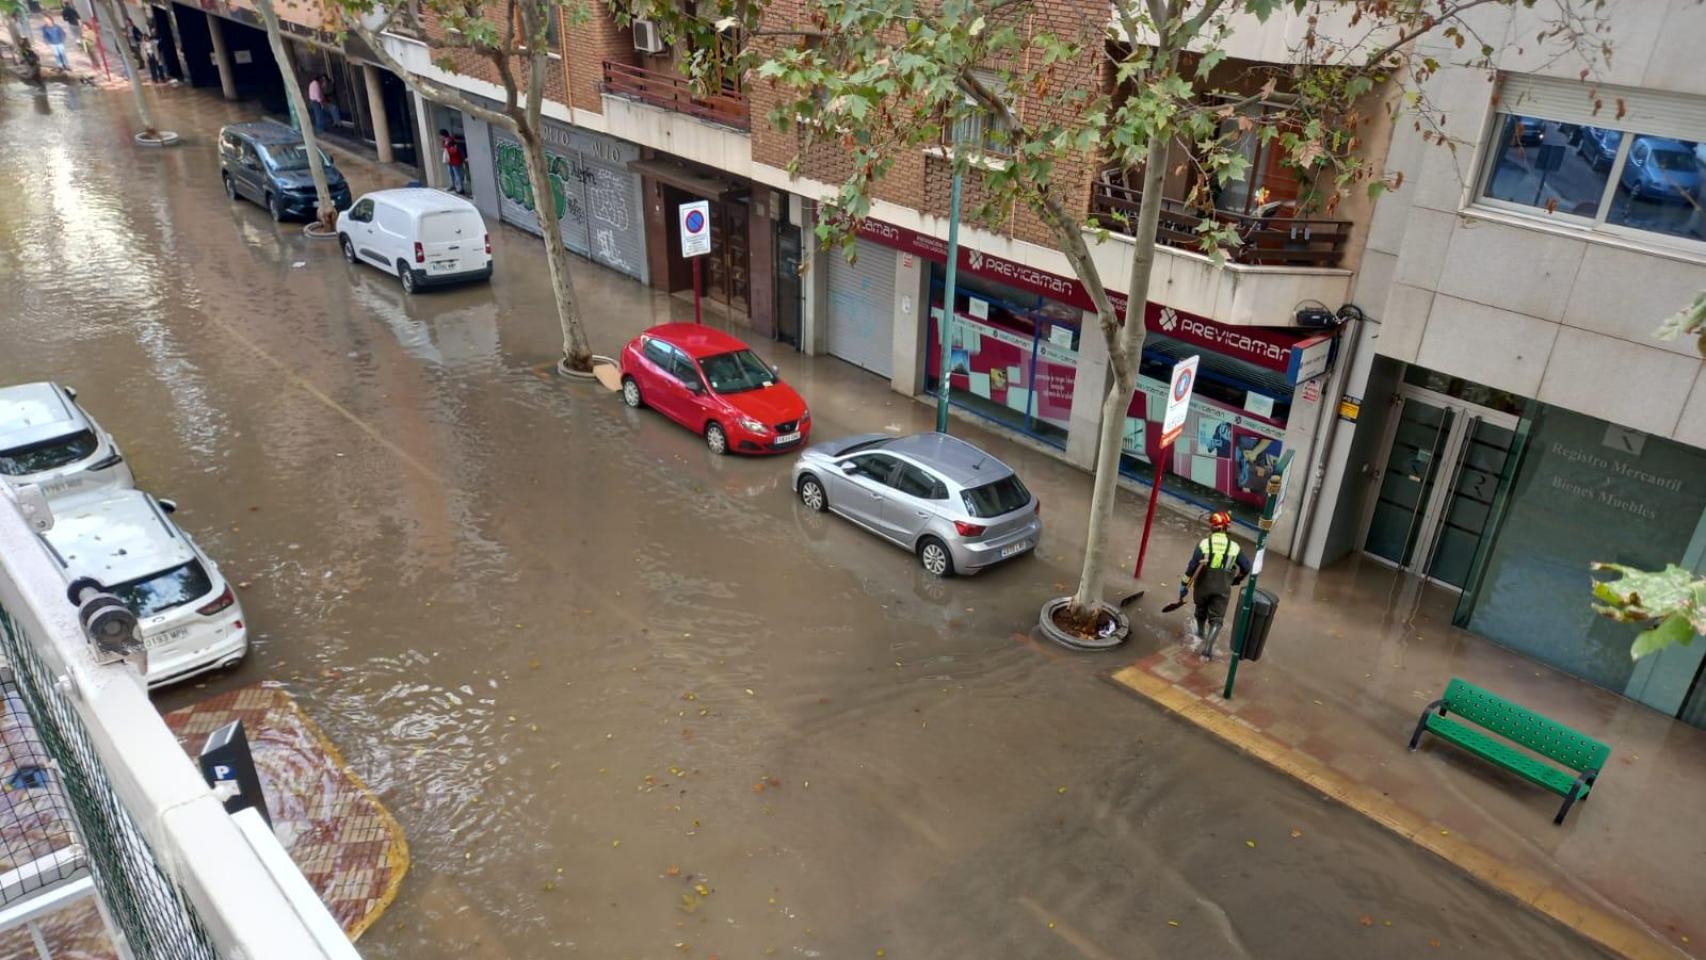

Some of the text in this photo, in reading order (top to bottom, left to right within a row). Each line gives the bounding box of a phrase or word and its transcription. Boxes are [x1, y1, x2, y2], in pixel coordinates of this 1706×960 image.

[1551, 441, 1683, 492] Registro Mercantil
[1551, 475, 1656, 519] Bienes Muebles
[214, 765, 230, 780] P
